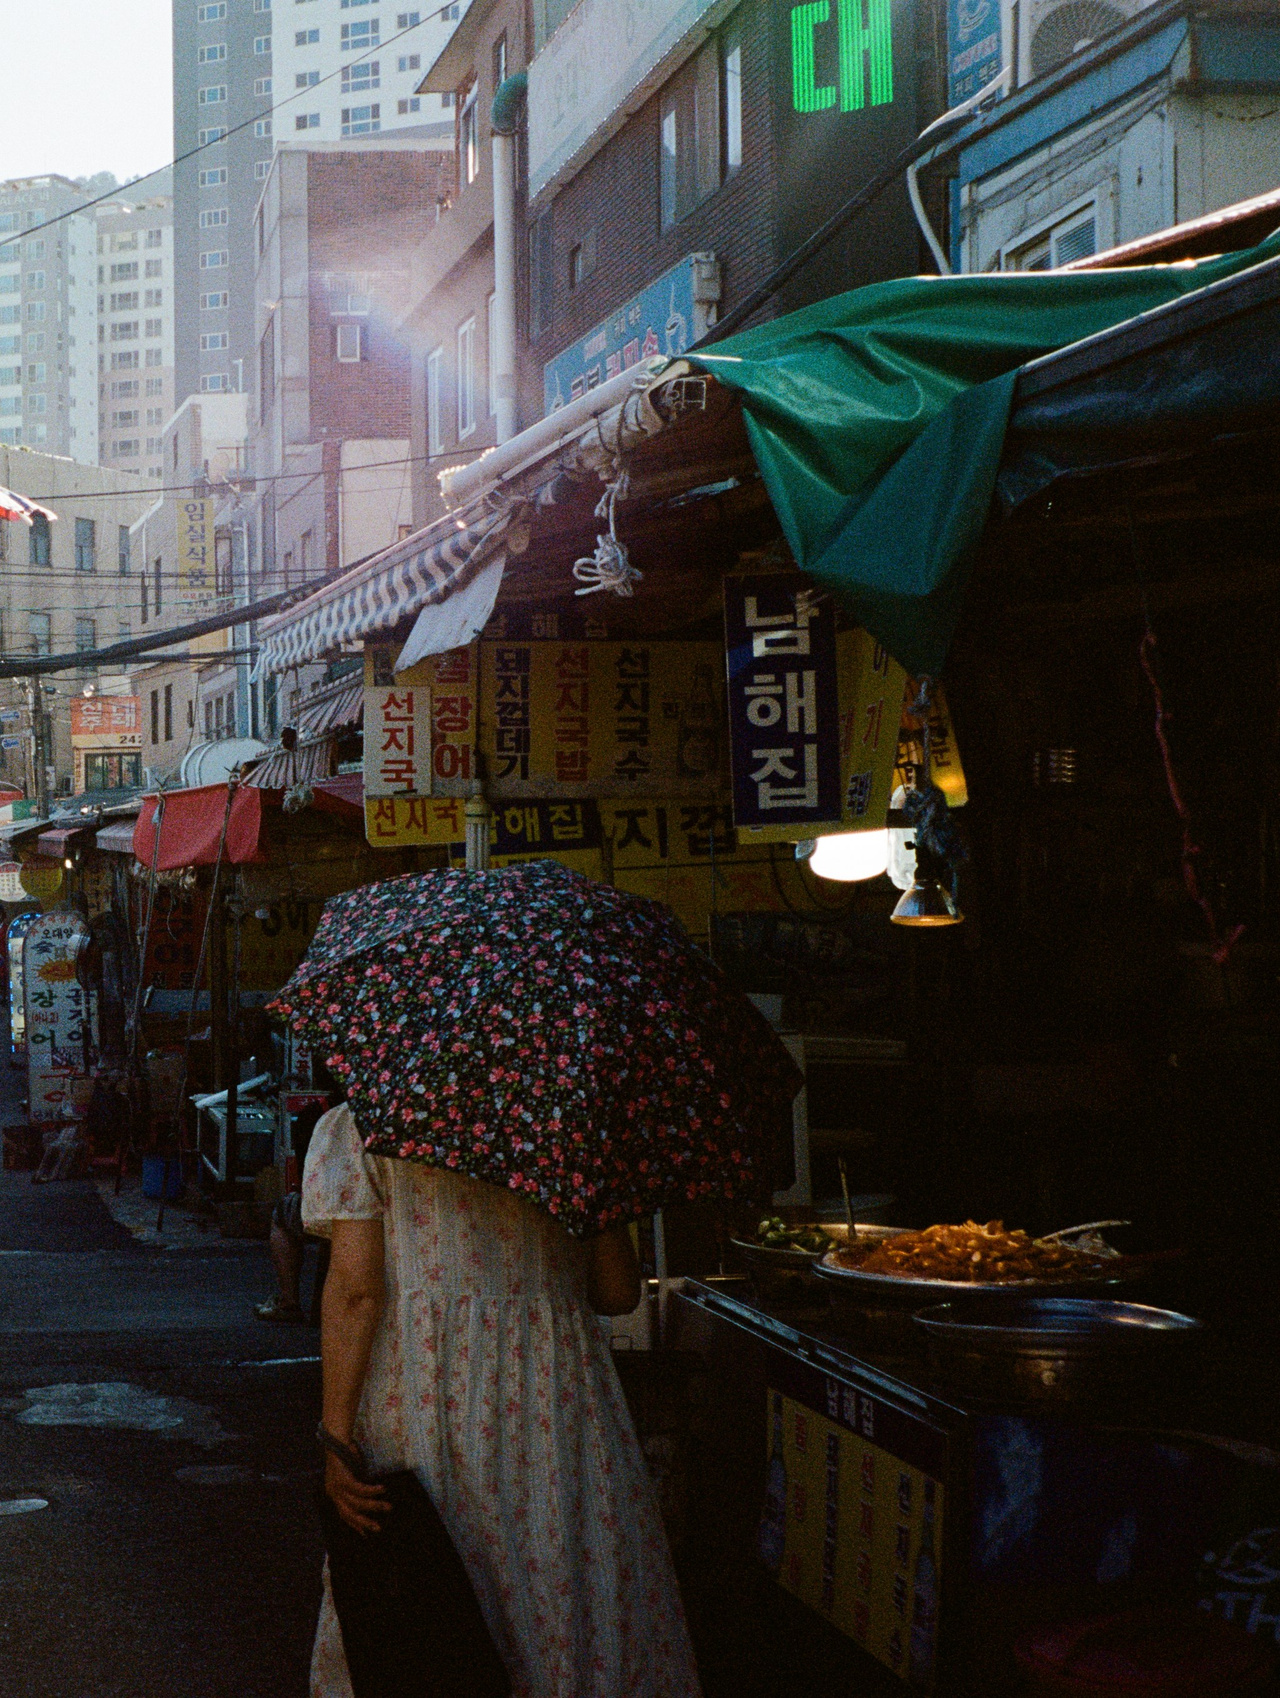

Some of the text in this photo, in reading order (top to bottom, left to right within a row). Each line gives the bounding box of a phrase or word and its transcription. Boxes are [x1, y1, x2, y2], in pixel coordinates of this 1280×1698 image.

[184, 503, 207, 589] 임실식품
[380, 692, 418, 792] 선지국
[553, 648, 591, 782] 선지국밥
[613, 648, 650, 781] 선지국수
[743, 589, 819, 810] 남해집
[373, 799, 460, 838] 선지국
